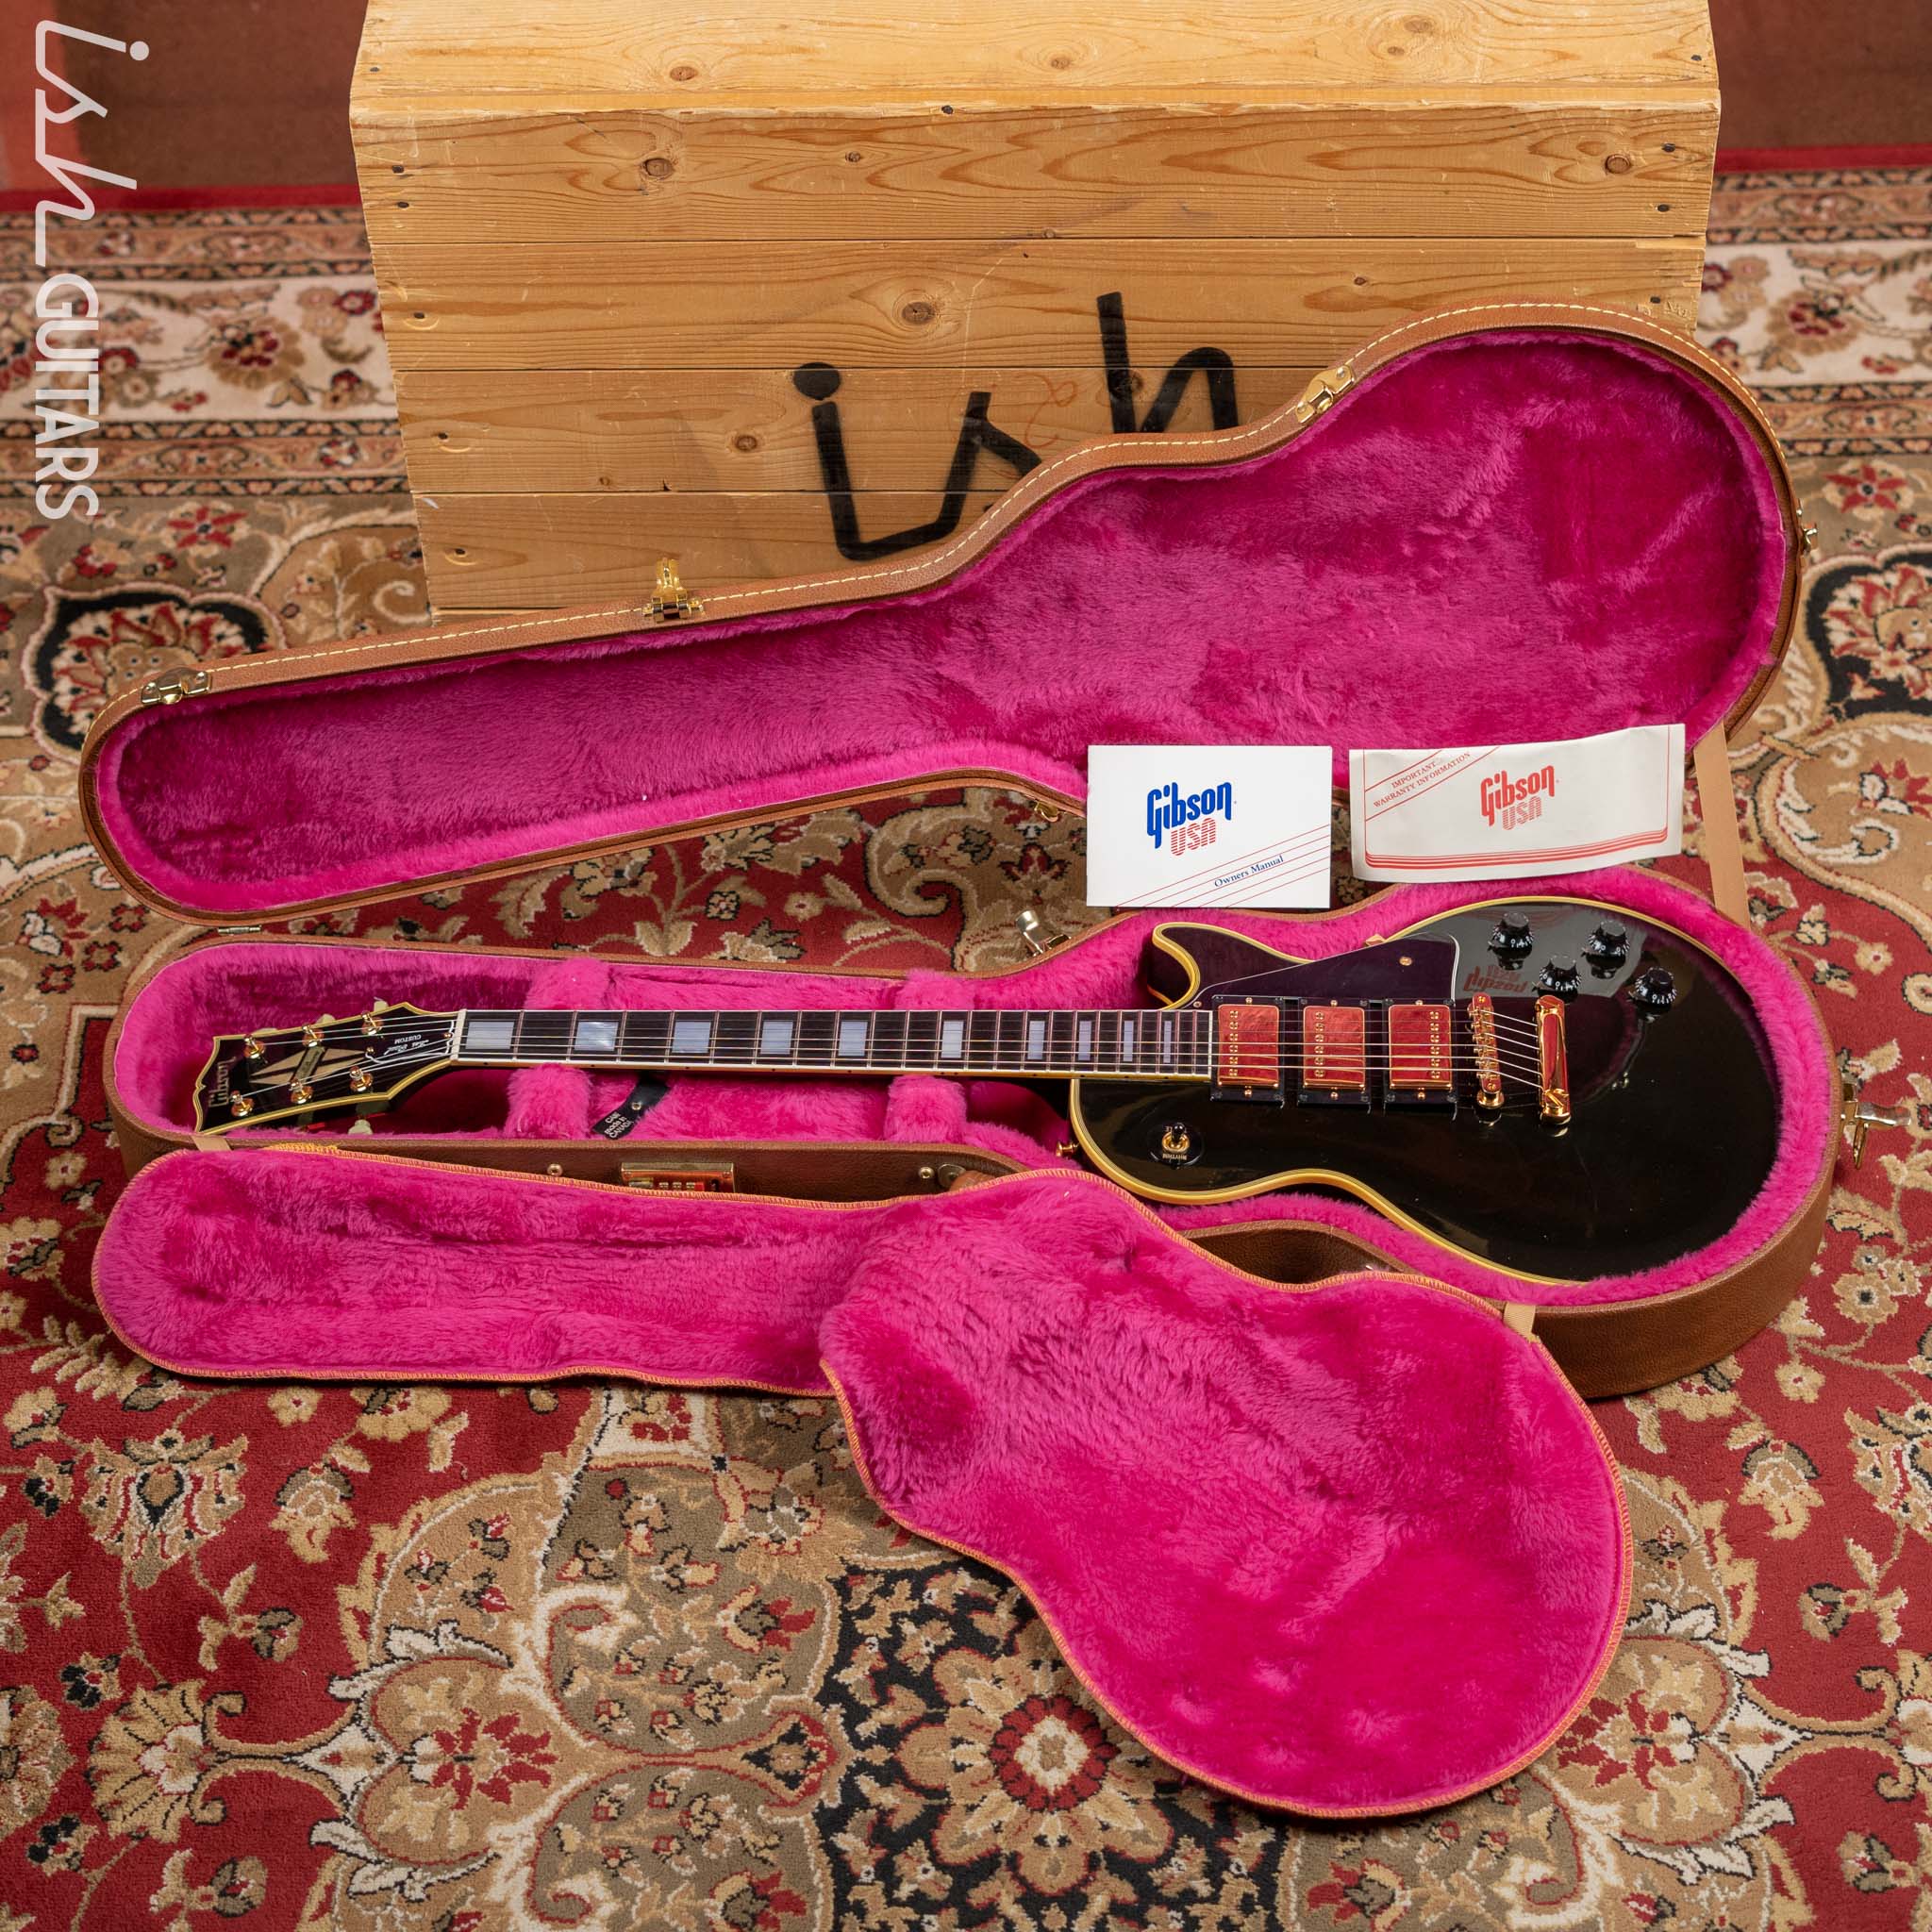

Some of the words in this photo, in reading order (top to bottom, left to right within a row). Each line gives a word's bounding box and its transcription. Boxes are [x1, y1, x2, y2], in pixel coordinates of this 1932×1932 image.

[1374, 784, 1416, 808] WARRANTY
[1418, 753, 1471, 786] INFORMATION
[1391, 761, 1436, 789] IMPORTANT
[1480, 765, 1555, 826] Gibson
[1502, 796, 1541, 830] USA
[1147, 782, 1232, 849] Gibson
[1171, 817, 1216, 856] USA
[1214, 869, 1250, 888] Owners
[1251, 856, 1284, 874] Manual
[394, 1034, 422, 1044] CUSTOM
